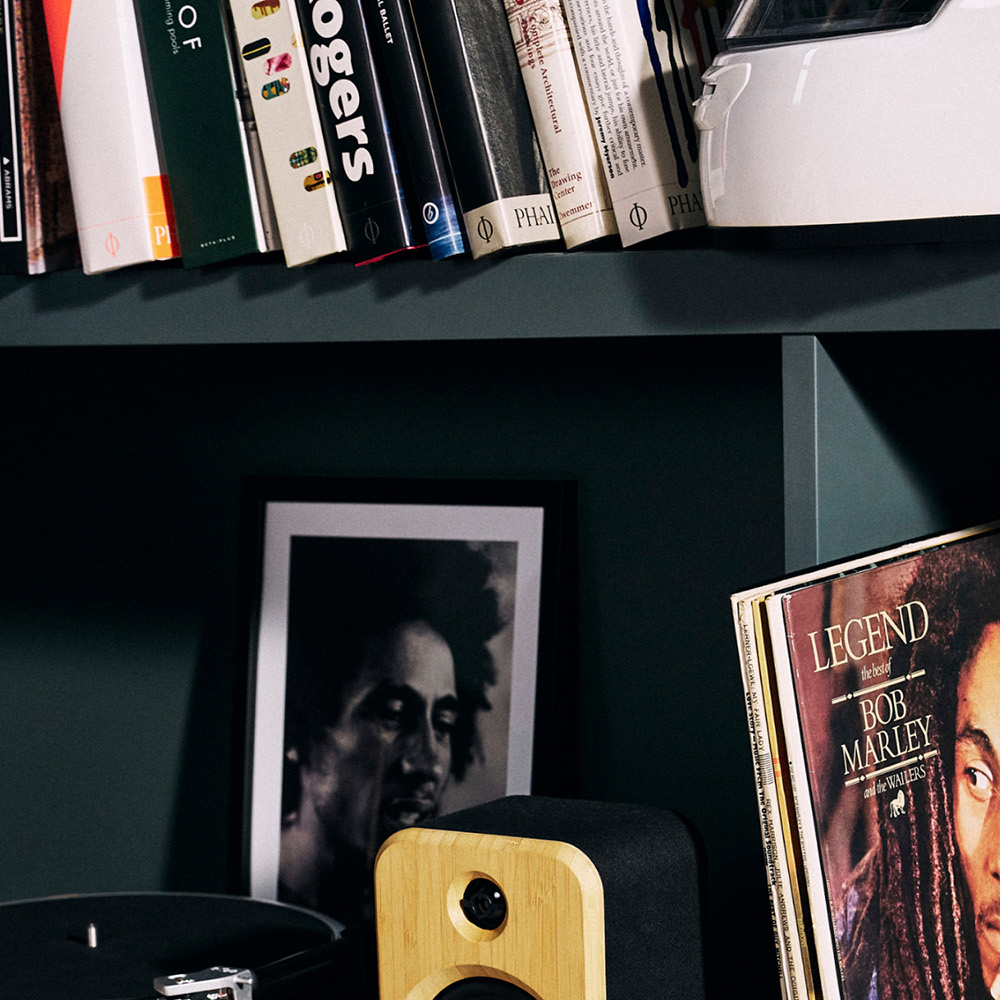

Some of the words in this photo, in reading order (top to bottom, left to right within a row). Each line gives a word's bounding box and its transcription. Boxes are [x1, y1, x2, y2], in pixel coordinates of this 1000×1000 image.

[379, 8, 394, 45] BALLET
[595, 9, 606, 32] around
[167, 27, 179, 54] pools
[529, 16, 545, 65] Complete
[541, 66, 561, 134] Architectural
[597, 54, 605, 67] and
[310, 0, 374, 182] ogers
[567, 0, 581, 40] companied
[595, 116, 605, 143] Jeremy
[603, 144, 614, 178] Myerson
[600, 68, 611, 90] lateral
[606, 16, 615, 37] hands
[611, 38, 619, 51] and
[615, 51, 625, 80] thoughts
[625, 97, 639, 142] contemporary
[584, 38, 593, 52] and
[609, 137, 619, 160] critical
[615, 162, 623, 176] and
[615, 128, 623, 148] ability
[620, 149, 625, 158] to
[2, 168, 13, 210] ABRAMS
[549, 167, 561, 177] The
[551, 169, 582, 189] Drawing
[554, 184, 577, 200] Center
[668, 192, 704, 215] PHA
[807, 600, 929, 673] LEGEND
[861, 665, 872, 681] the
[871, 663, 886, 679] best
[885, 656, 892, 677] of
[859, 689, 906, 731] BOB
[841, 714, 931, 775] MARLEY
[863, 781, 876, 799] and
[876, 779, 888, 794] the
[886, 764, 926, 790] WAILERS
[755, 729, 764, 752] LADY
[784, 934, 792, 953] AND
[760, 808, 770, 838] Original
[766, 839, 776, 886] Soundtrack
